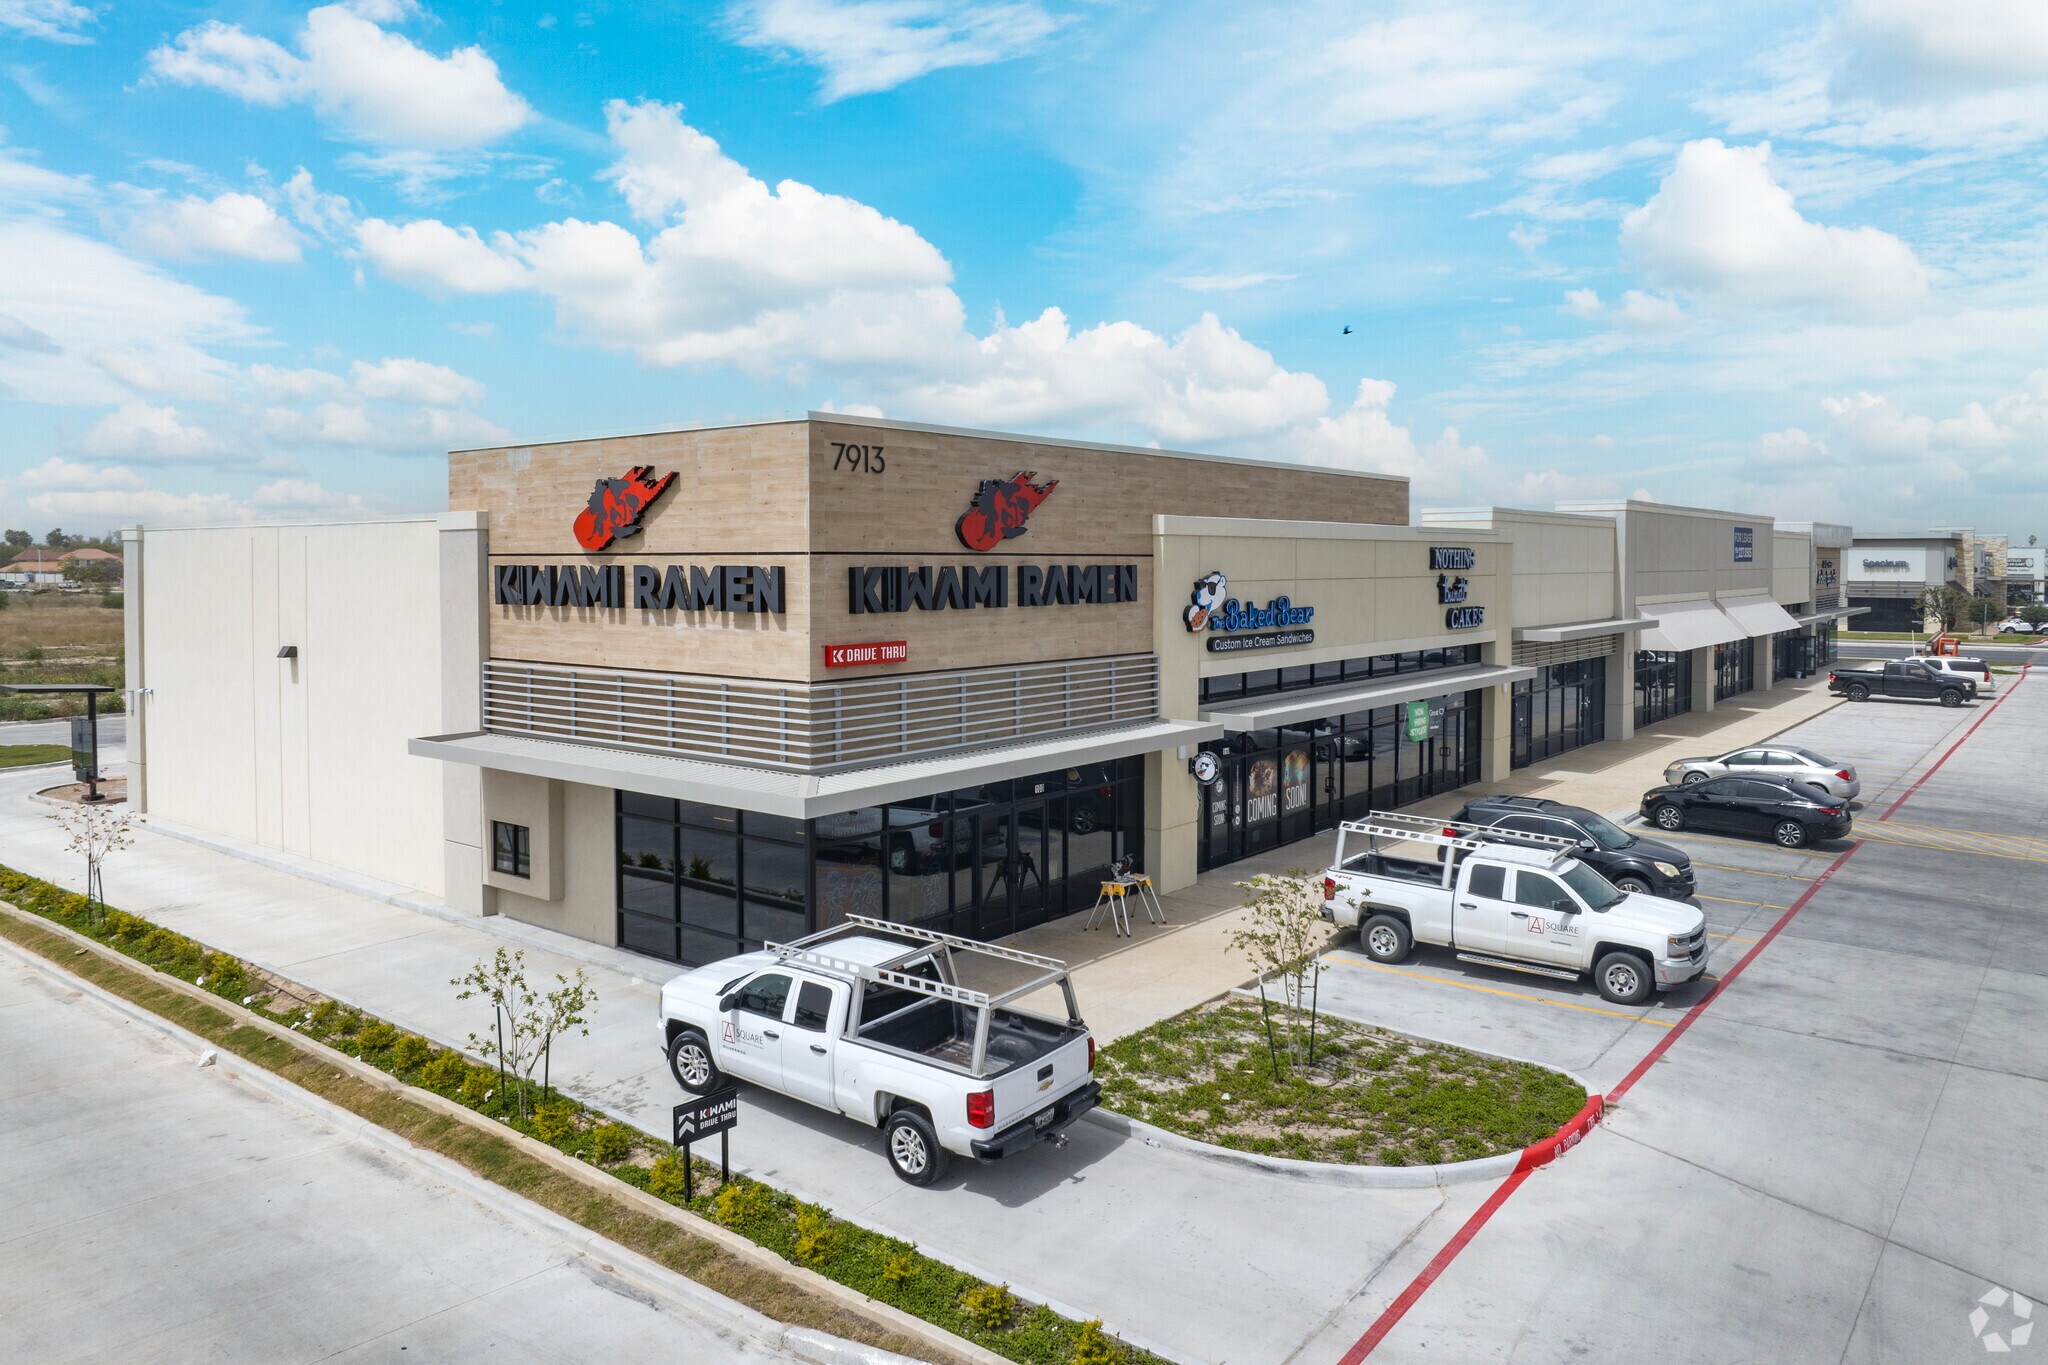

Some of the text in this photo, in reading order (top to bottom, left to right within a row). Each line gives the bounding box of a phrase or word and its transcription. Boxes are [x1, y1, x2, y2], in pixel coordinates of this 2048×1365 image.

[830, 442, 886, 474] 7913
[1431, 547, 1475, 570] NOTHING
[1862, 558, 1909, 568] Spectrum
[634, 564, 786, 614] RAMEN
[1017, 564, 1138, 607] RAMEN
[1224, 598, 1277, 632] Baked
[1277, 595, 1314, 628] Bear
[1446, 606, 1484, 629] CAKES
[1214, 632, 1313, 651] Custom Ice Cream Sandwiches
[846, 645, 906, 663] DRIVE THRU
[1247, 793, 1277, 823] COMING
[1285, 783, 1307, 810] SOON!
[1545, 921, 1579, 935] SQUARE
[735, 1028, 764, 1045] SQUARE
[700, 1098, 737, 1120] KIWAMI
[700, 1110, 737, 1130] DRIVE THRU
